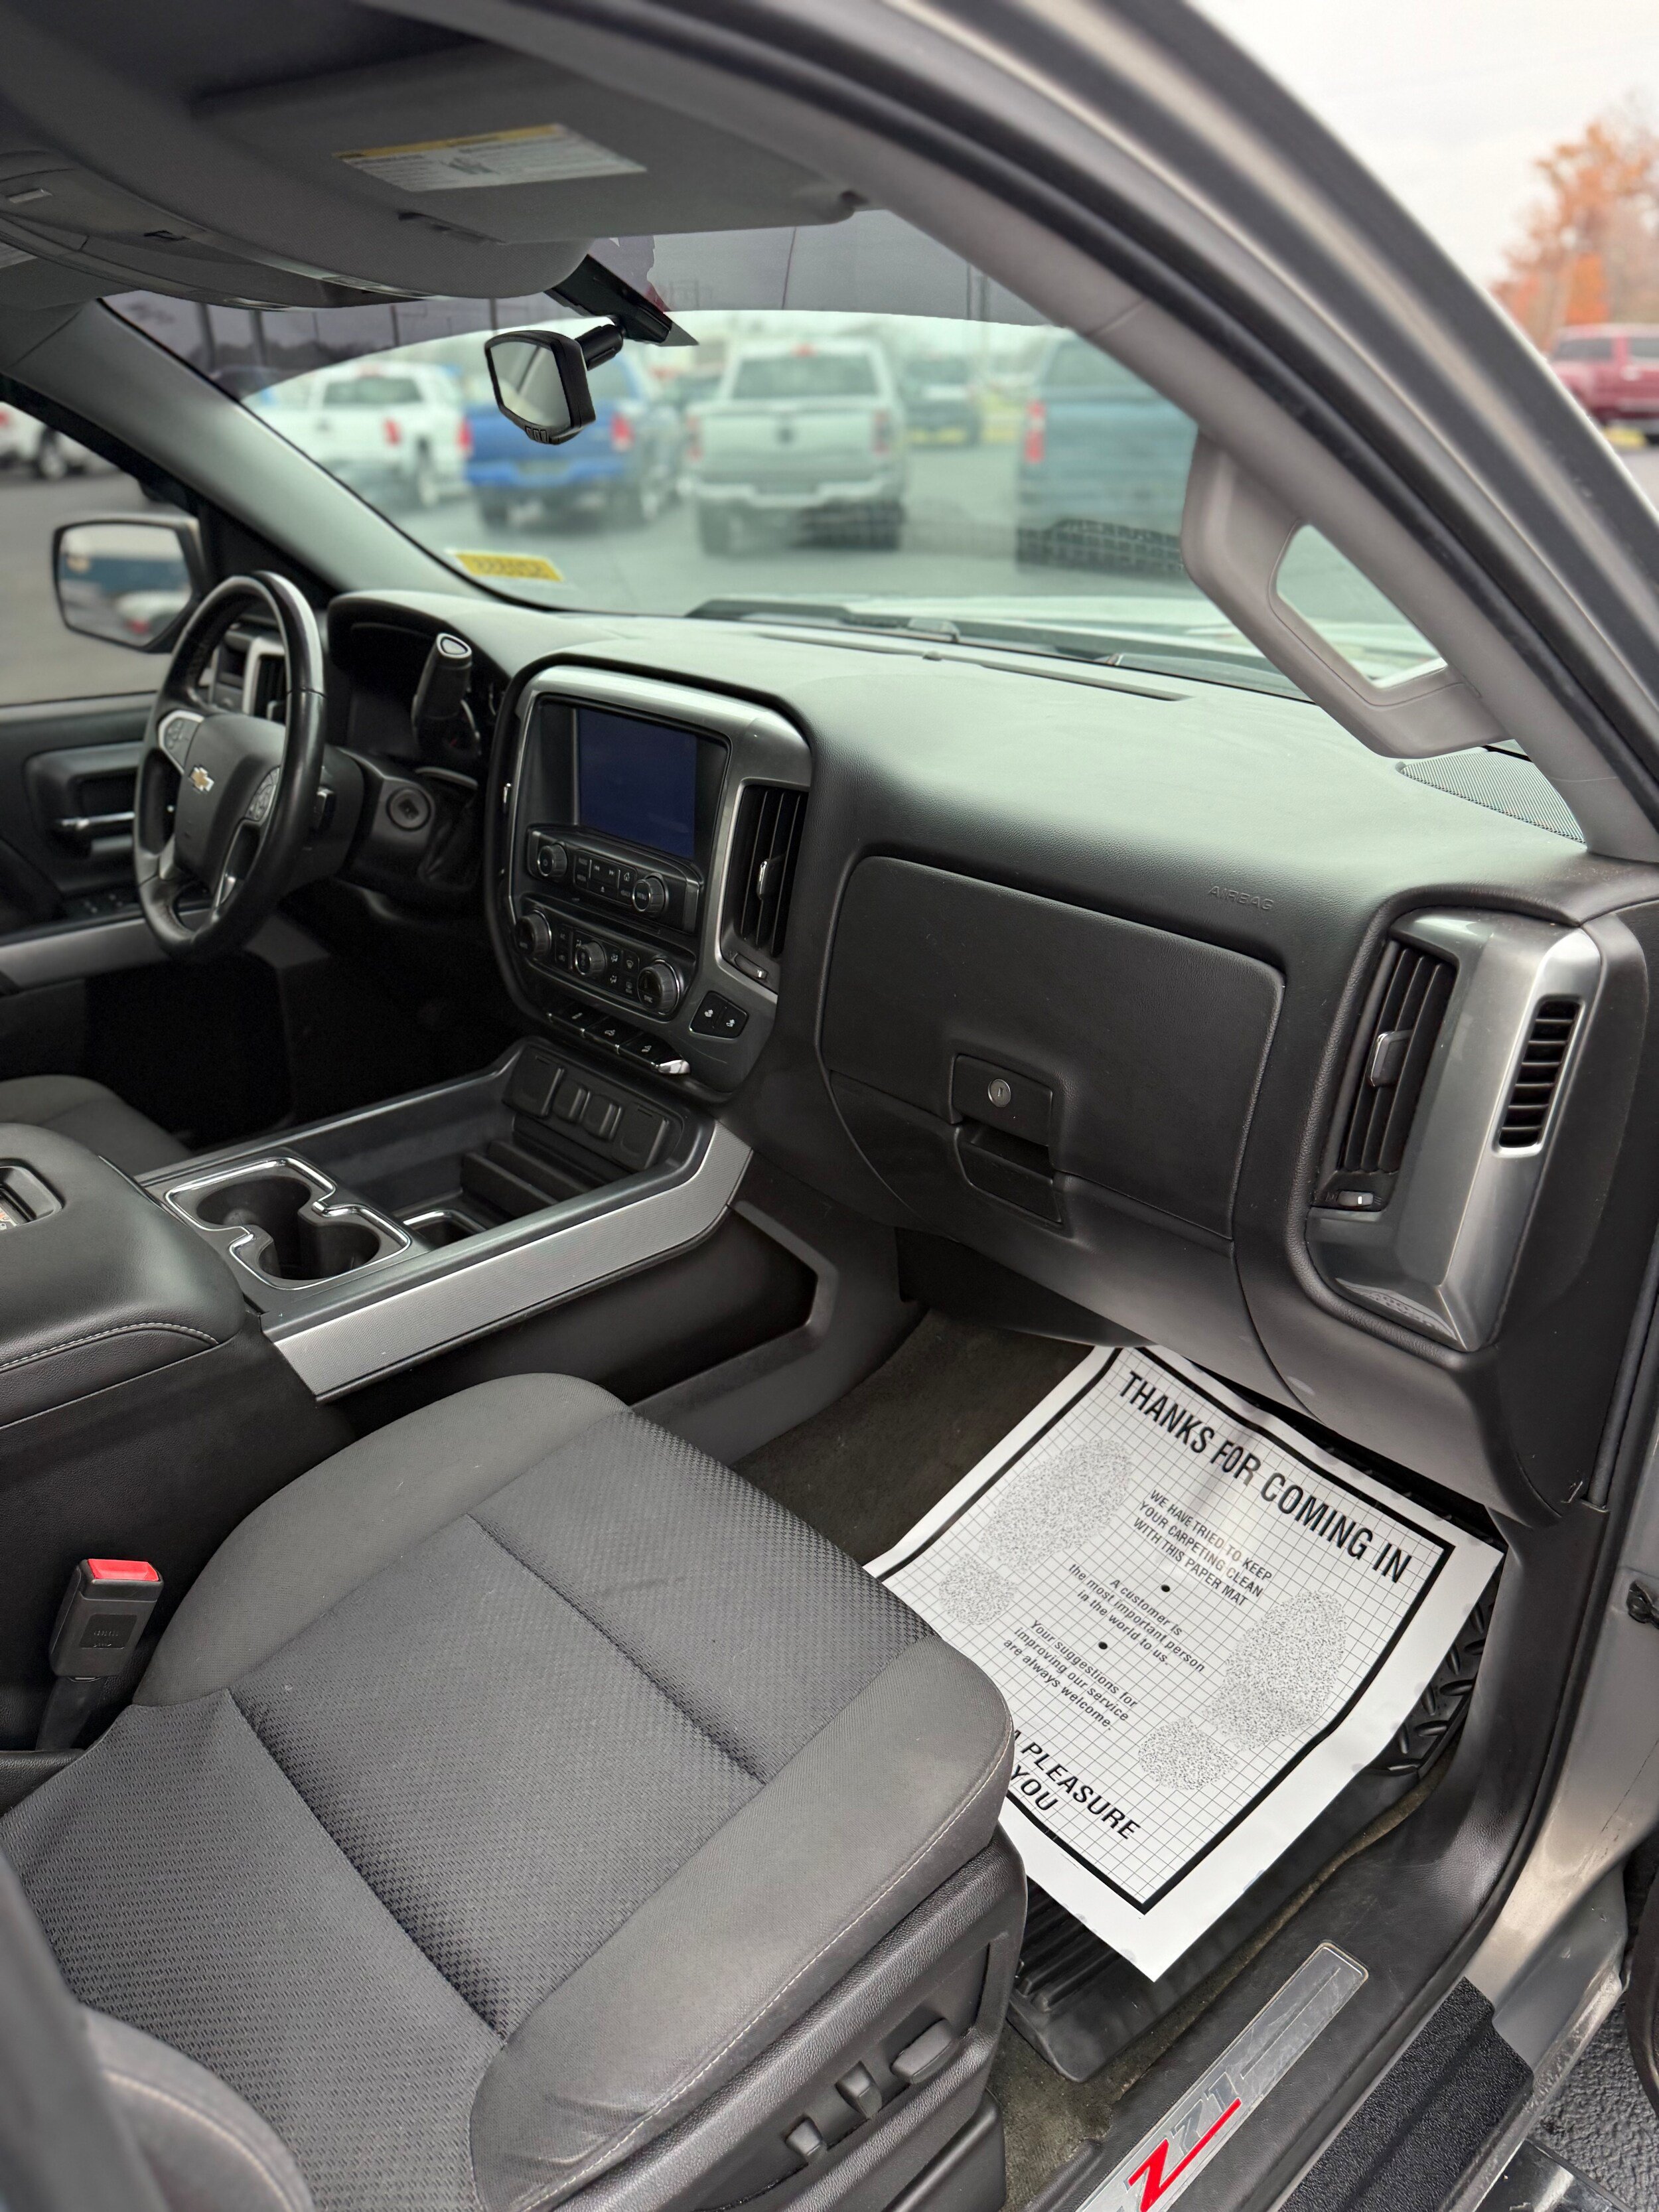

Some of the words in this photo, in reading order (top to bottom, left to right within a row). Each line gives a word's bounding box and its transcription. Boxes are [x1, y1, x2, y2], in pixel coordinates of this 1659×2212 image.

[1208, 885, 1274, 910] AIRBAG
[1120, 1370, 1214, 1453] THANKS
[1210, 1439, 1261, 1487] FOR
[1261, 1473, 1373, 1560] COMING
[1372, 1542, 1412, 1584] IN
[1134, 1518, 1162, 1544] WITH
[1161, 1540, 1185, 1562] THIS
[1185, 1558, 1222, 1589] PAPER
[1222, 1585, 1248, 1606] MAT
[1139, 1501, 1168, 1528] YOUR
[1169, 1526, 1226, 1571] CARPETING
[1227, 1568, 1263, 1597] CLEAN
[1150, 1490, 1168, 1508] WE
[1167, 1504, 1193, 1526] HAVE
[1192, 1520, 1224, 1549] TRIED
[1226, 1544, 1242, 1562] TO
[1242, 1557, 1272, 1581] KEEP
[1069, 1564, 1086, 1580] the
[1086, 1580, 1114, 1602] most
[1114, 1599, 1168, 1643] important
[1164, 1641, 1205, 1672] person
[1078, 1589, 1090, 1601] in
[1090, 1599, 1108, 1615] the
[1108, 1614, 1141, 1641] world
[1139, 1637, 1152, 1651] to
[1153, 1649, 1169, 1665] us.
[1110, 1580, 1120, 1589] A
[1120, 1587, 1171, 1626] customer
[1171, 1624, 1183, 1636] is
[1003, 1639, 1023, 1656] are
[1023, 1655, 1060, 1688] always
[1062, 1686, 1112, 1731] welcome.
[1014, 1627, 1068, 1674] improving
[1068, 1672, 1088, 1688] our
[1087, 1687, 1129, 1722] service
[1031, 1620, 1056, 1643] Your
[1054, 1641, 1119, 1694] suggestions
[1119, 1692, 1138, 1708] for
[1011, 1765, 1058, 1810] YOU
[1020, 1741, 1141, 1840] PLEASURE
[1123, 2071, 1242, 2212] Z71
